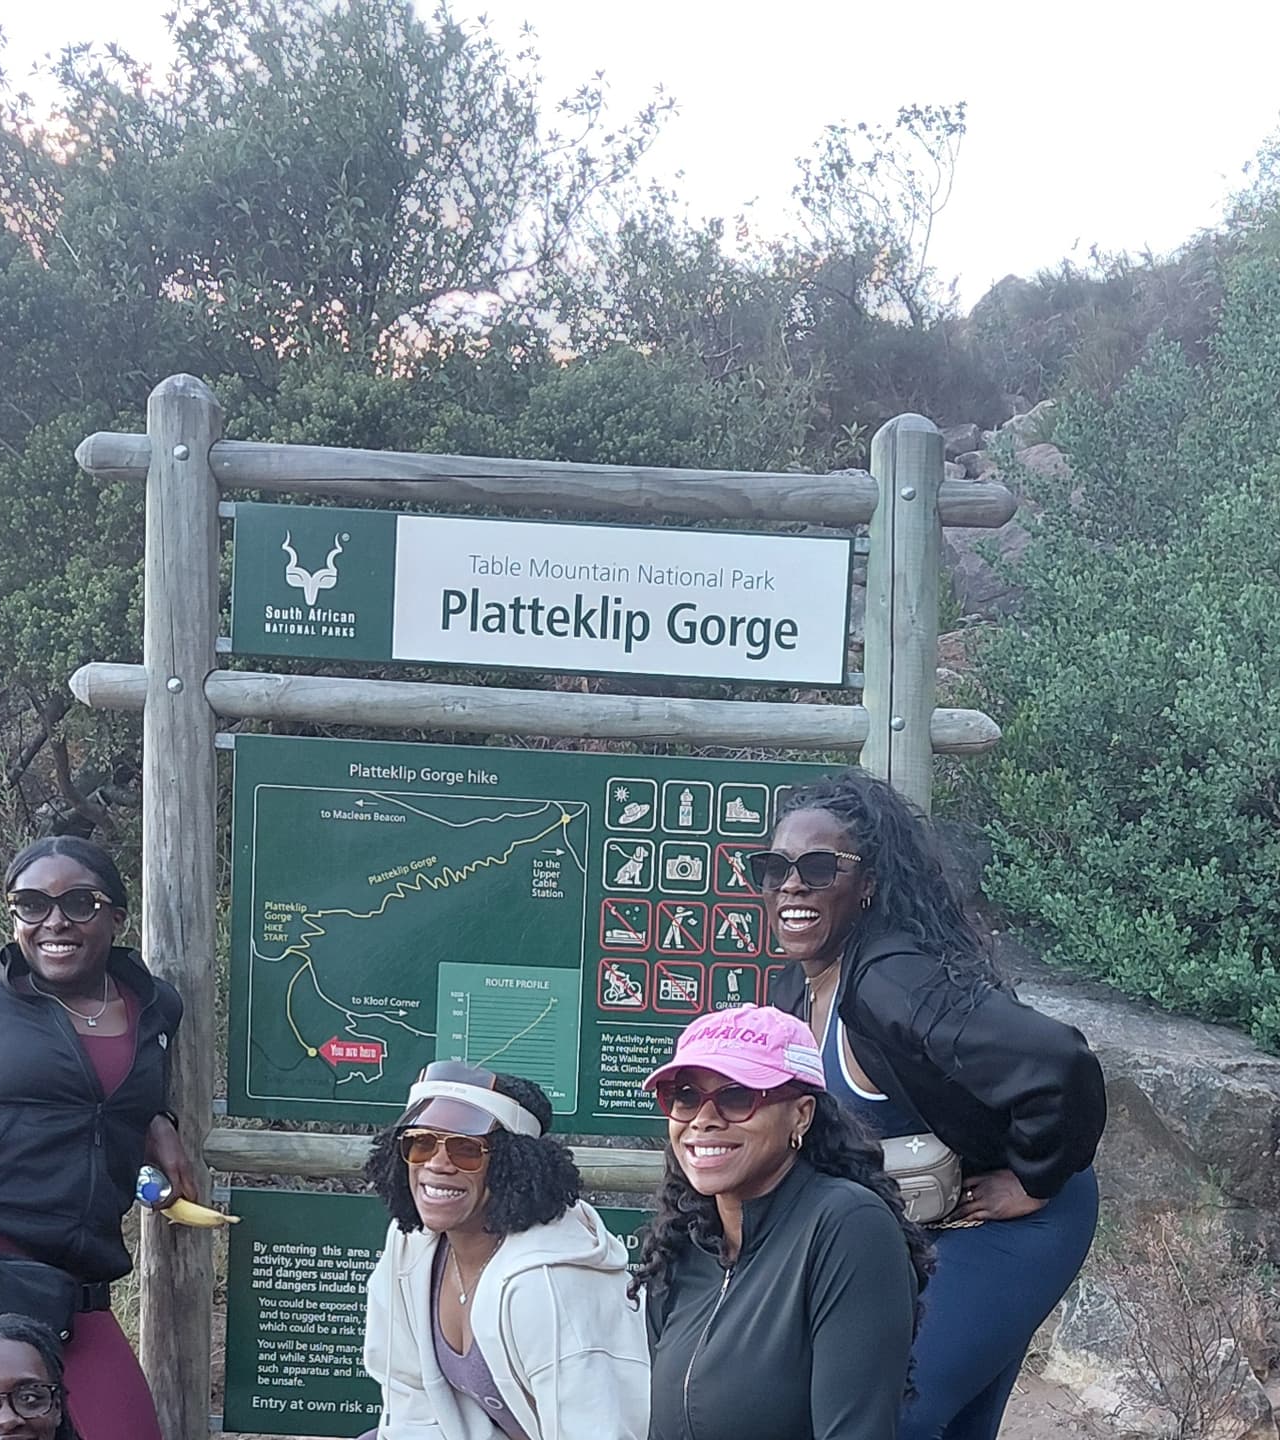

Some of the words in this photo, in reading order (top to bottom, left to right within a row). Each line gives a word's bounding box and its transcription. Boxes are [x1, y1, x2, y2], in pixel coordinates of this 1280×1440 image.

[469, 555, 521, 576] Table
[529, 558, 630, 583] Mountain
[637, 563, 723, 588] National
[731, 569, 775, 592] Park
[265, 605, 303, 620] South
[308, 608, 356, 624] African
[265, 622, 317, 635] NATIONAL
[321, 625, 356, 638] PARKS
[440, 588, 651, 653] Platteklip
[666, 602, 799, 661] Gorge
[349, 763, 417, 782] Platteklip
[420, 767, 465, 786] Gorge
[467, 769, 499, 784] hike
[321, 810, 331, 818] to
[373, 812, 406, 822] Beacon
[533, 859, 543, 868] to
[545, 858, 561, 869] the
[368, 865, 410, 886] Platteklip
[410, 855, 438, 870] Gorge
[533, 868, 561, 879] Upper
[532, 878, 558, 888] Cable
[531, 888, 564, 898] Station
[264, 901, 308, 914] Platteklip
[264, 911, 292, 923] Gorge
[263, 923, 284, 932] HIKE
[263, 933, 289, 942] START
[485, 977, 514, 988] ROUTE
[515, 979, 550, 990] PROFILE
[351, 996, 362, 1005] to
[363, 996, 389, 1006] Kloof
[390, 998, 421, 1008] Corner
[727, 993, 741, 1002] NO
[601, 1033, 614, 1044] My
[614, 1034, 644, 1046] Activity
[645, 1035, 674, 1045] Permits
[330, 1044, 345, 1056] You
[345, 1047, 358, 1057] are
[359, 1045, 377, 1058] here
[601, 1045, 615, 1053] are
[616, 1045, 649, 1054] required
[650, 1045, 662, 1054] for
[663, 1046, 673, 1055] all
[601, 1053, 618, 1064] Dog
[619, 1054, 649, 1064] Walkers
[651, 1055, 657, 1064] &
[601, 1063, 619, 1072] Rock
[600, 1088, 625, 1097] Events
[626, 1089, 633, 1098] &
[634, 1089, 651, 1098] Film
[599, 1097, 610, 1108] by
[610, 1099, 637, 1109] permit
[637, 1100, 655, 1110] only
[253, 1241, 268, 1255] By
[272, 1243, 317, 1257] entering
[322, 1245, 342, 1256] this
[347, 1247, 370, 1258] area
[252, 1254, 293, 1268] activity,
[295, 1258, 315, 1269] you
[317, 1259, 334, 1268] are
[335, 1258, 377, 1270] volunta
[252, 1266, 273, 1277] and
[275, 1267, 318, 1281] dangers
[320, 1270, 348, 1281] usual
[350, 1271, 367, 1282] for
[252, 1278, 273, 1289] and
[274, 1279, 317, 1292] dangers
[319, 1281, 356, 1293] include
[258, 1297, 277, 1307] You
[278, 1299, 304, 1309] could
[306, 1299, 318, 1309] be
[319, 1301, 358, 1312] exposed
[260, 1309, 278, 1319] and
[280, 1310, 291, 1320] to
[291, 1312, 326, 1323] rugged
[327, 1313, 361, 1324] terrain,
[259, 1321, 287, 1331] which
[289, 1322, 315, 1333] could
[317, 1324, 329, 1333] be
[331, 1326, 338, 1334] a
[339, 1325, 356, 1335] risk
[257, 1338, 276, 1349] You
[277, 1340, 294, 1350] will
[295, 1340, 308, 1351] be
[310, 1342, 335, 1354] using
[258, 1351, 277, 1361] and
[279, 1352, 306, 1363] while
[308, 1353, 353, 1365] SANParks
[257, 1363, 279, 1373] such
[282, 1365, 330, 1377] apparatus
[333, 1367, 352, 1377] and
[257, 1375, 270, 1385] be
[271, 1377, 306, 1386] unsafe.
[252, 1396, 287, 1412] Entry
[290, 1398, 305, 1410] at
[307, 1401, 336, 1411] own
[340, 1400, 363, 1413] risk
[366, 1403, 382, 1414] an
